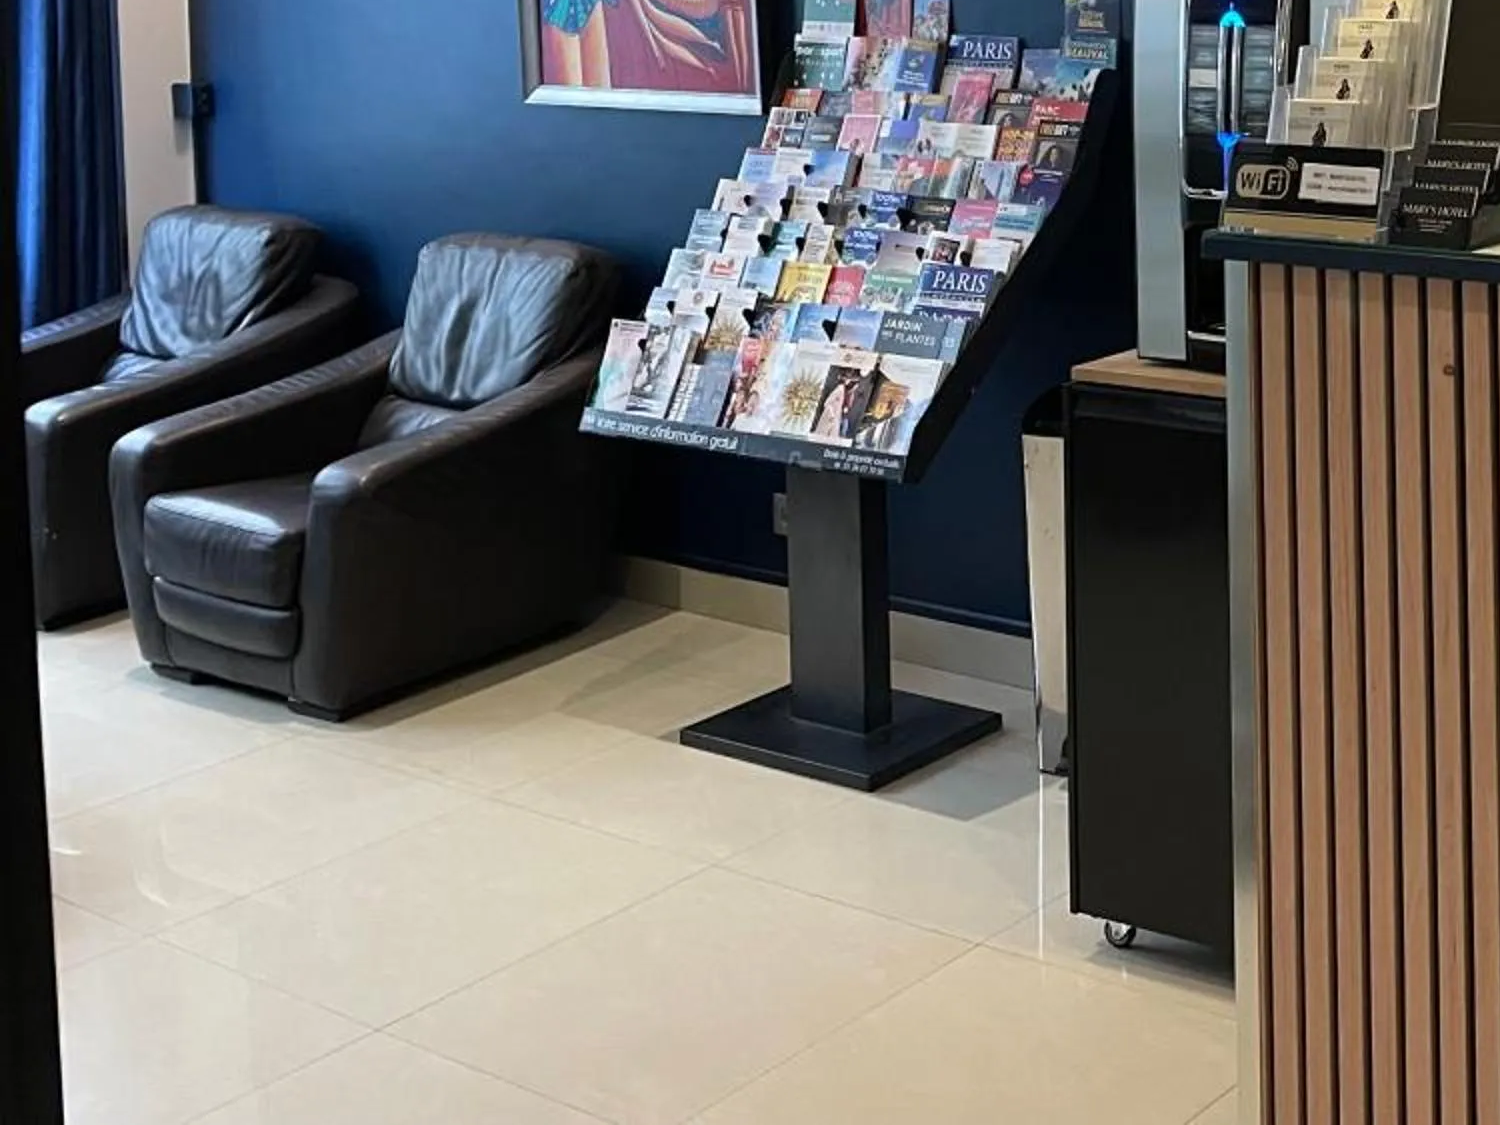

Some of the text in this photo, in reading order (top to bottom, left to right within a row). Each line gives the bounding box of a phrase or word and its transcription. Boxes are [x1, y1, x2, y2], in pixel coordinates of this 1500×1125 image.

[962, 40, 1014, 61] PARIS
[931, 269, 989, 295] PARIS
[884, 318, 923, 333] JARDIN
[617, 422, 650, 437] service
